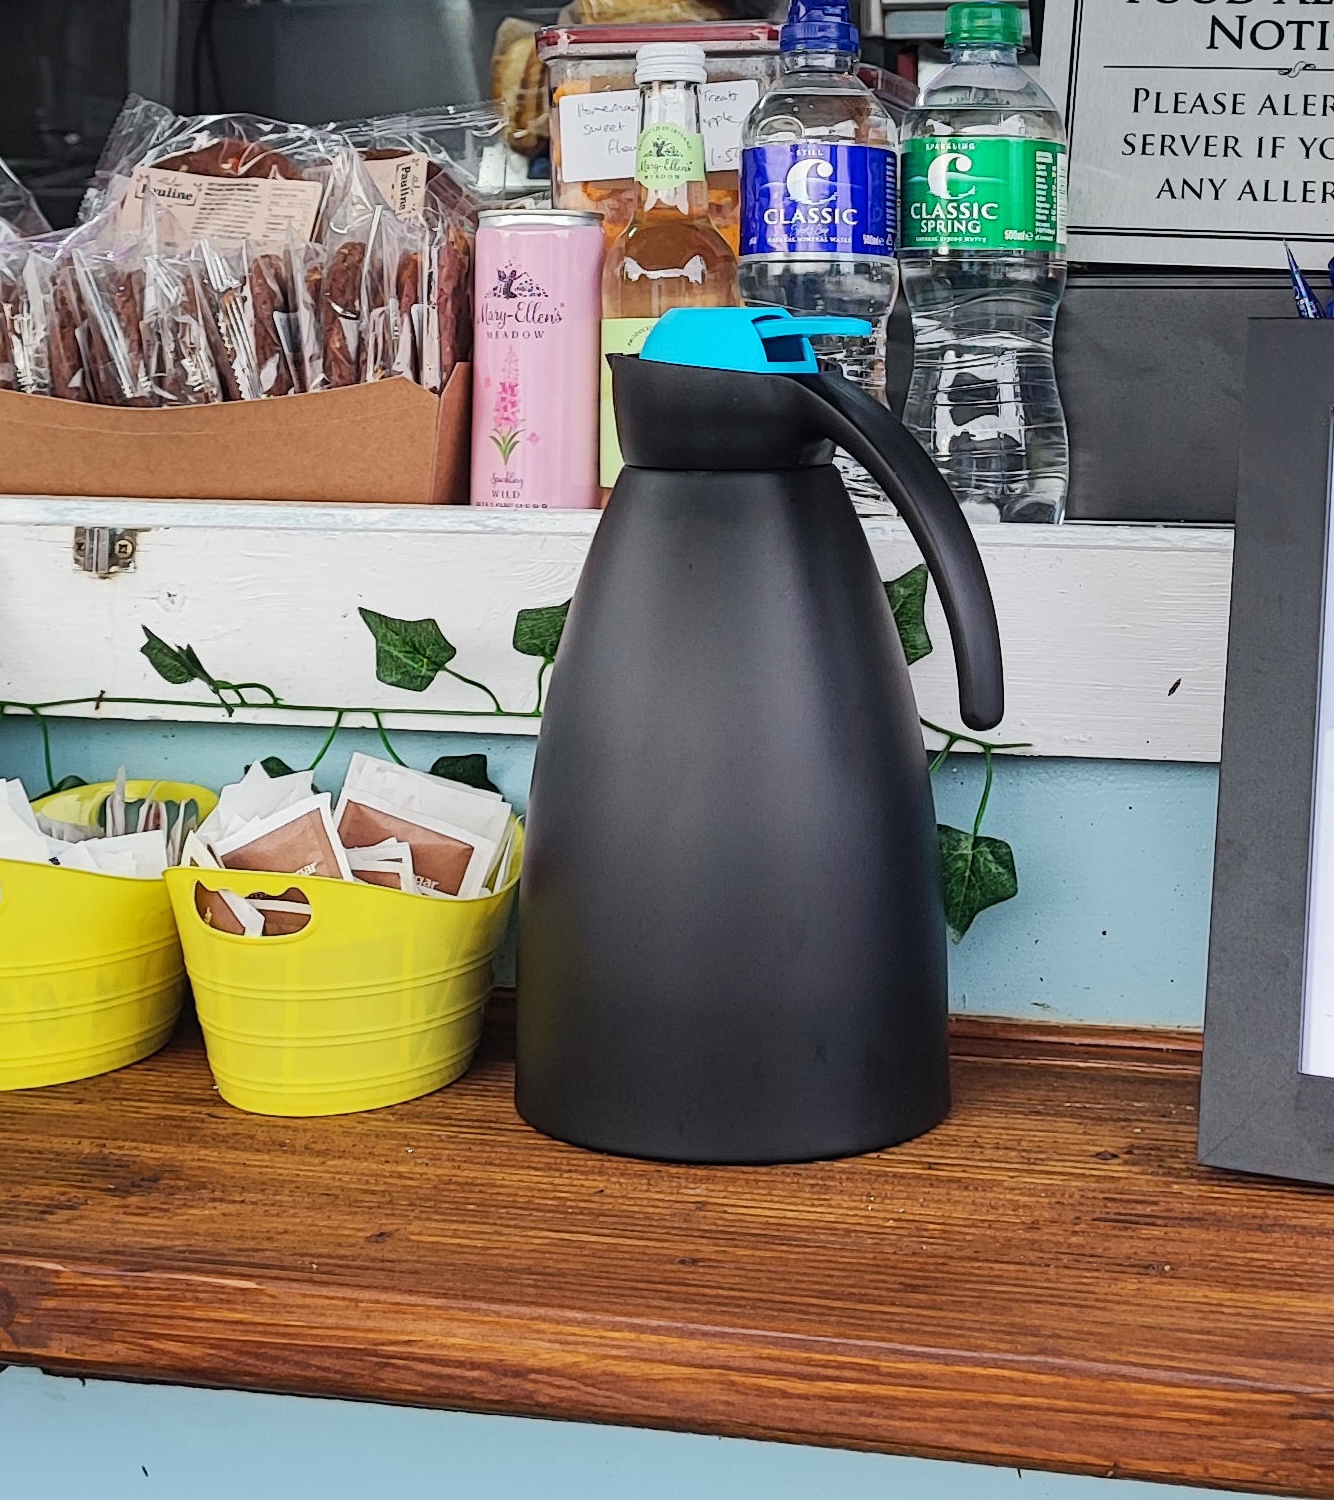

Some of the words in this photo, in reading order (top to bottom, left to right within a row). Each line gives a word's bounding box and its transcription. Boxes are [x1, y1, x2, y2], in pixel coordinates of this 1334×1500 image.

[1131, 86, 1246, 117] PLEASE
[1121, 133, 1242, 159] SERVER
[1255, 135, 1284, 160] IF
[398, 165, 413, 211] Pauline
[1155, 177, 1228, 201] ANY
[763, 207, 859, 225] CLASSIC
[910, 201, 1000, 220] CLASSIC
[920, 219, 982, 235] SPRING
[476, 301, 563, 329] Mary-Ellen's
[486, 330, 545, 340] MEADOW
[491, 489, 521, 499] WILD
